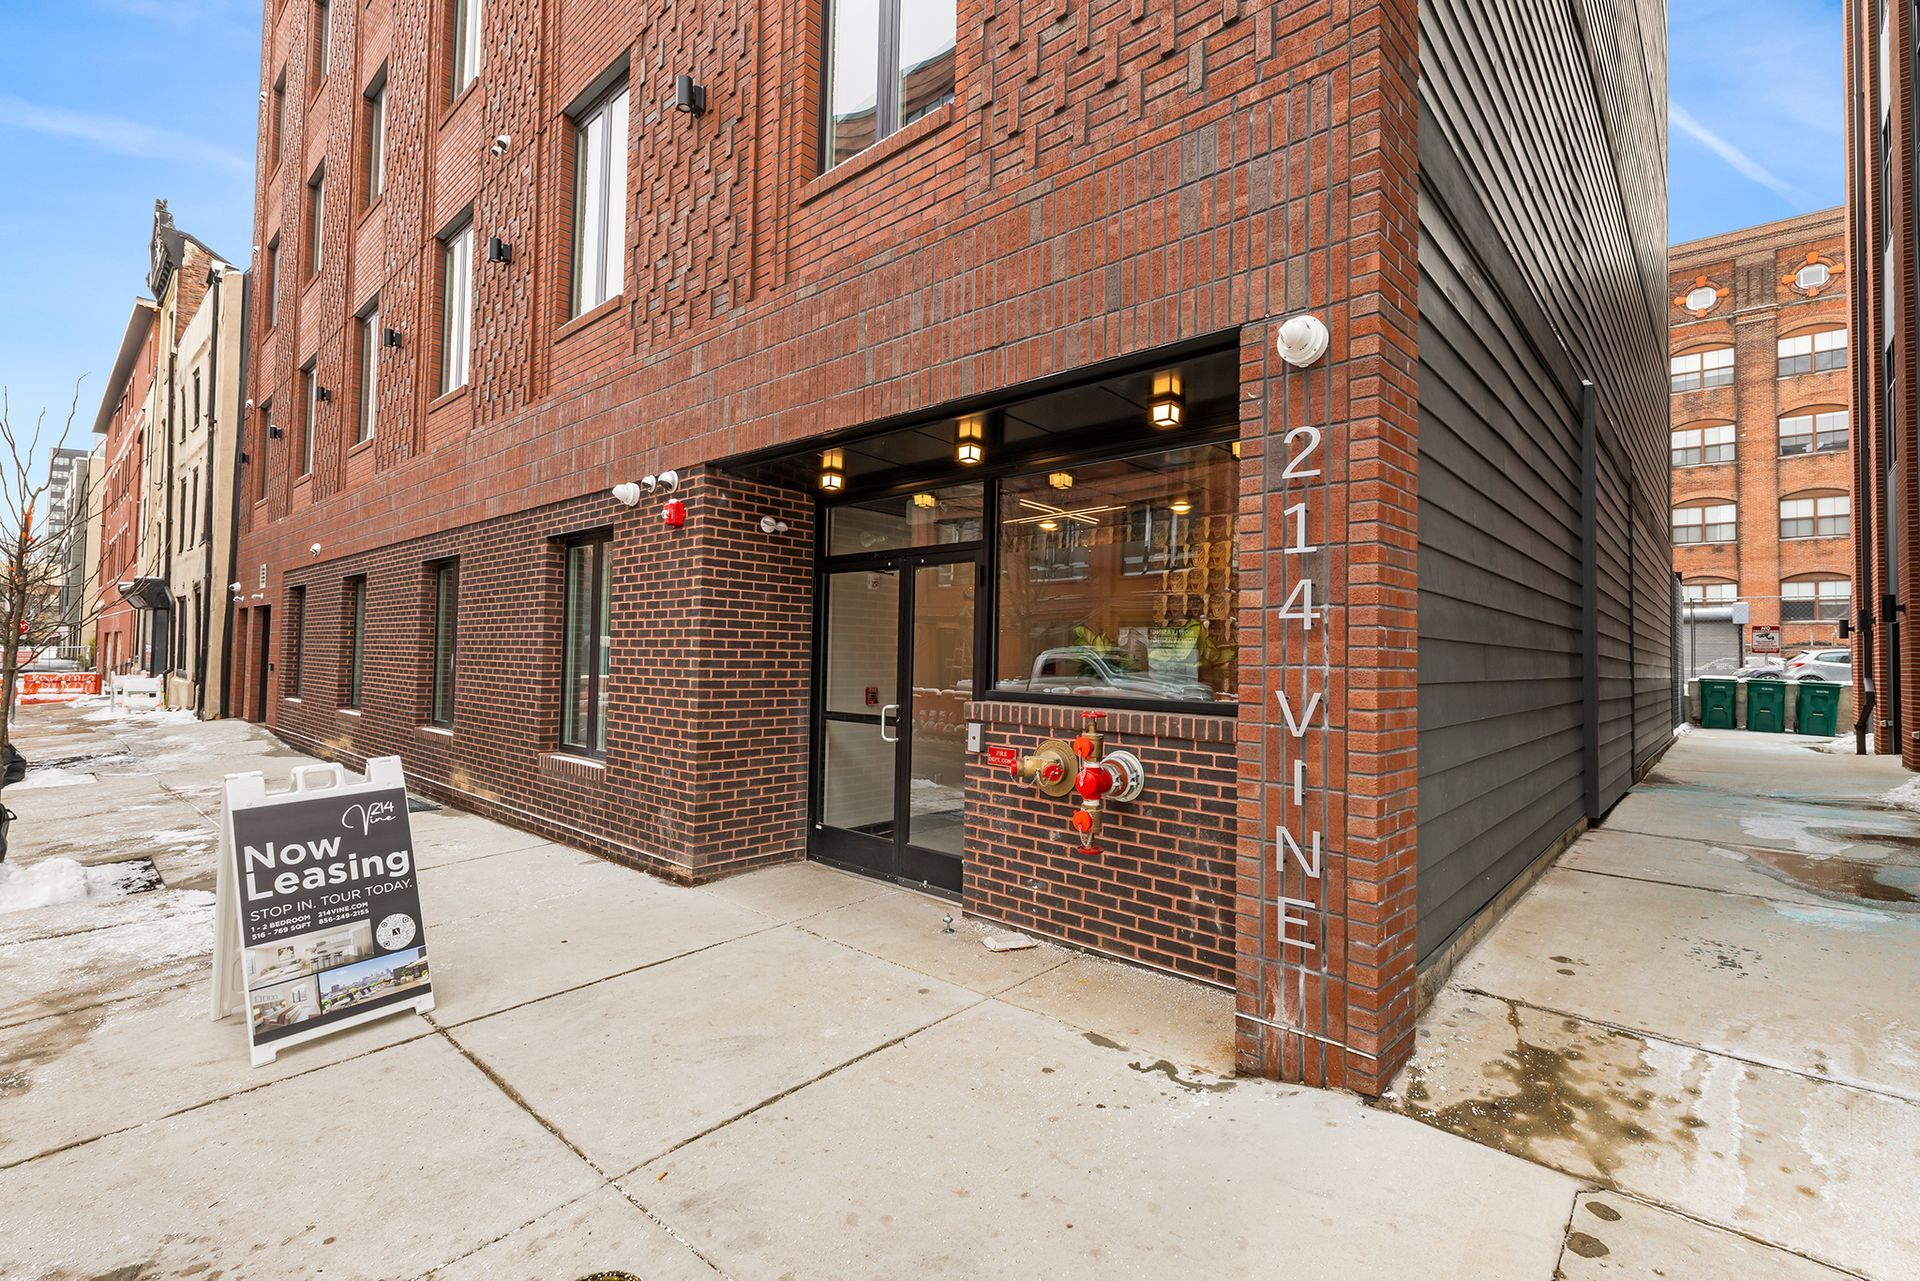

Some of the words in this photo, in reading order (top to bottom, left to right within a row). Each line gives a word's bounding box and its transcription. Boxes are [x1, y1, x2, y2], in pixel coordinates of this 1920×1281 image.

[1279, 426, 1322, 631] 214
[341, 803, 397, 836] Vine
[371, 800, 395, 816] 214
[1274, 688, 1322, 951] VINE
[243, 836, 342, 873] Now
[245, 849, 411, 902] Leasing
[250, 903, 292, 922] STOP
[297, 899, 317, 912] IN.
[320, 889, 361, 906] TOUR
[364, 878, 413, 896] TODAY.
[317, 901, 369, 918] 214VINE.COM
[318, 908, 370, 925] 856-249-2155
[252, 932, 265, 941] 516
[274, 926, 289, 935] 769
[290, 922, 312, 932] SQFT
[269, 914, 311, 928] BEDROOM
